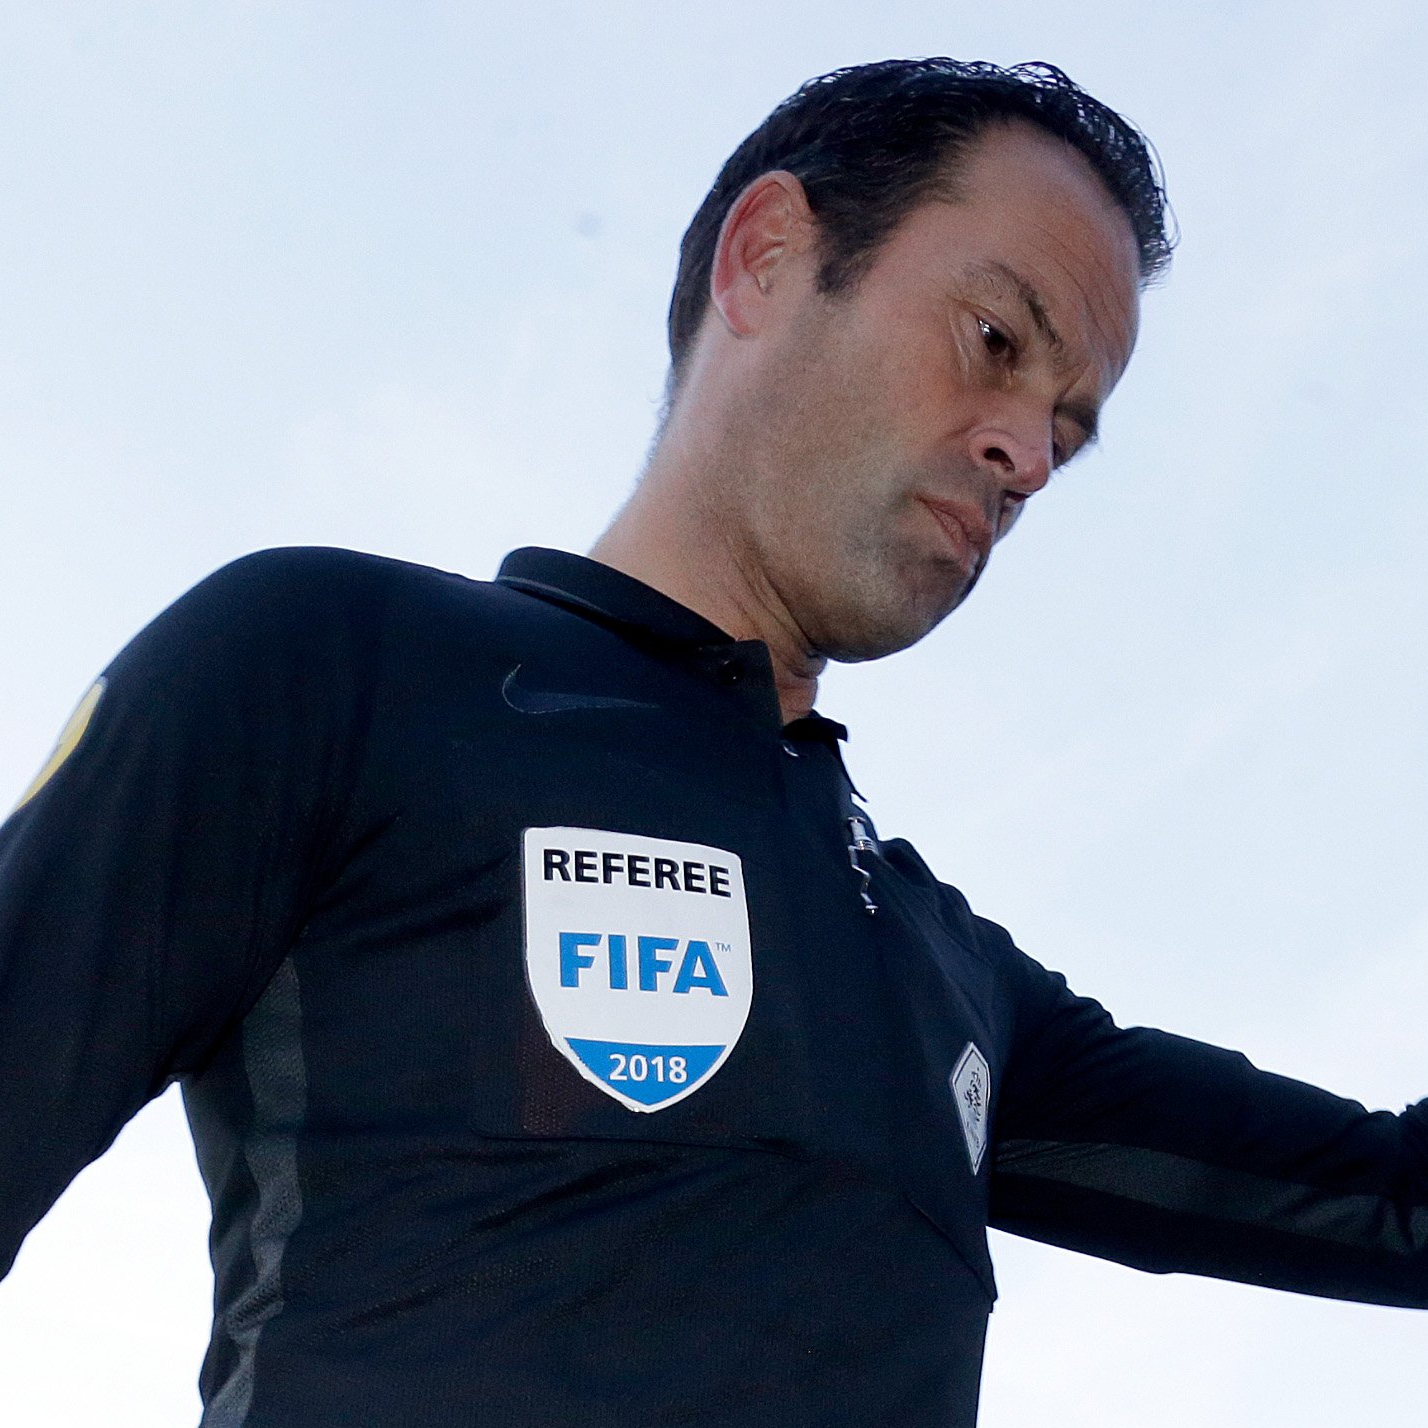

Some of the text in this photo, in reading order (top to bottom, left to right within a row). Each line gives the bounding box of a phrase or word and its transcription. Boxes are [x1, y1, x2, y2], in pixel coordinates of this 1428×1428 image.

[542, 848, 732, 898] REFEREE
[558, 931, 729, 997] FIFA
[608, 1052, 688, 1084] 2018
